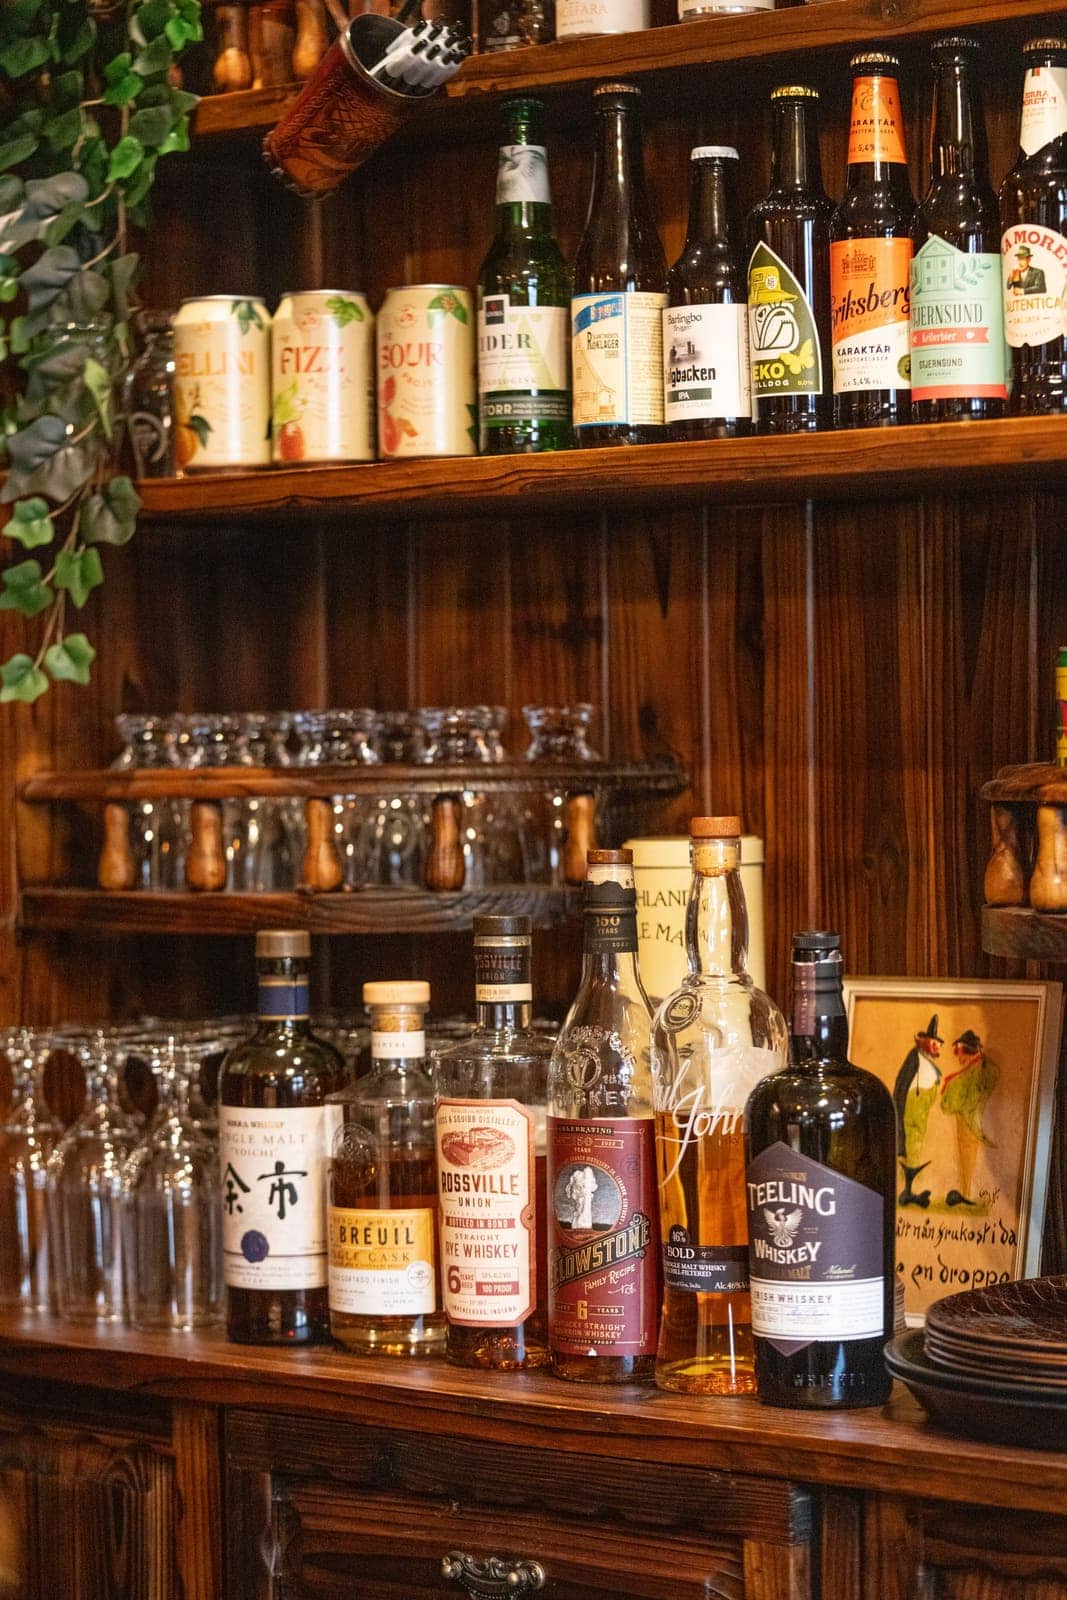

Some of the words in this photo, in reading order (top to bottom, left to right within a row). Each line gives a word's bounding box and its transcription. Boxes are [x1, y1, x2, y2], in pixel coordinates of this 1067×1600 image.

[911, 303, 983, 328] TJERNSUND
[481, 333, 533, 353] IDER
[175, 350, 256, 377] ELLINI
[380, 341, 443, 370] SOUR
[752, 362, 785, 382] EKO
[678, 391, 690, 401] IPA
[441, 1171, 520, 1196] ROSSVILLE
[458, 1196, 492, 1208] UNION
[747, 1180, 838, 1217] TEELING
[339, 1225, 415, 1246] BREUIL
[454, 1232, 501, 1242] STRAIGHT
[462, 1243, 519, 1259] WHISKEY
[667, 1246, 695, 1260] BOLD
[753, 1237, 823, 1266] WHISKEY
[447, 1264, 462, 1295] 6
[608, 1262, 637, 1285] RECIPE
[777, 1293, 834, 1305] WHISKEY
[577, 1299, 589, 1321] 6
[596, 1307, 620, 1315] YEARS
[584, 1322, 626, 1332] STRAIGHT
[584, 1330, 622, 1339] WHISKEY
